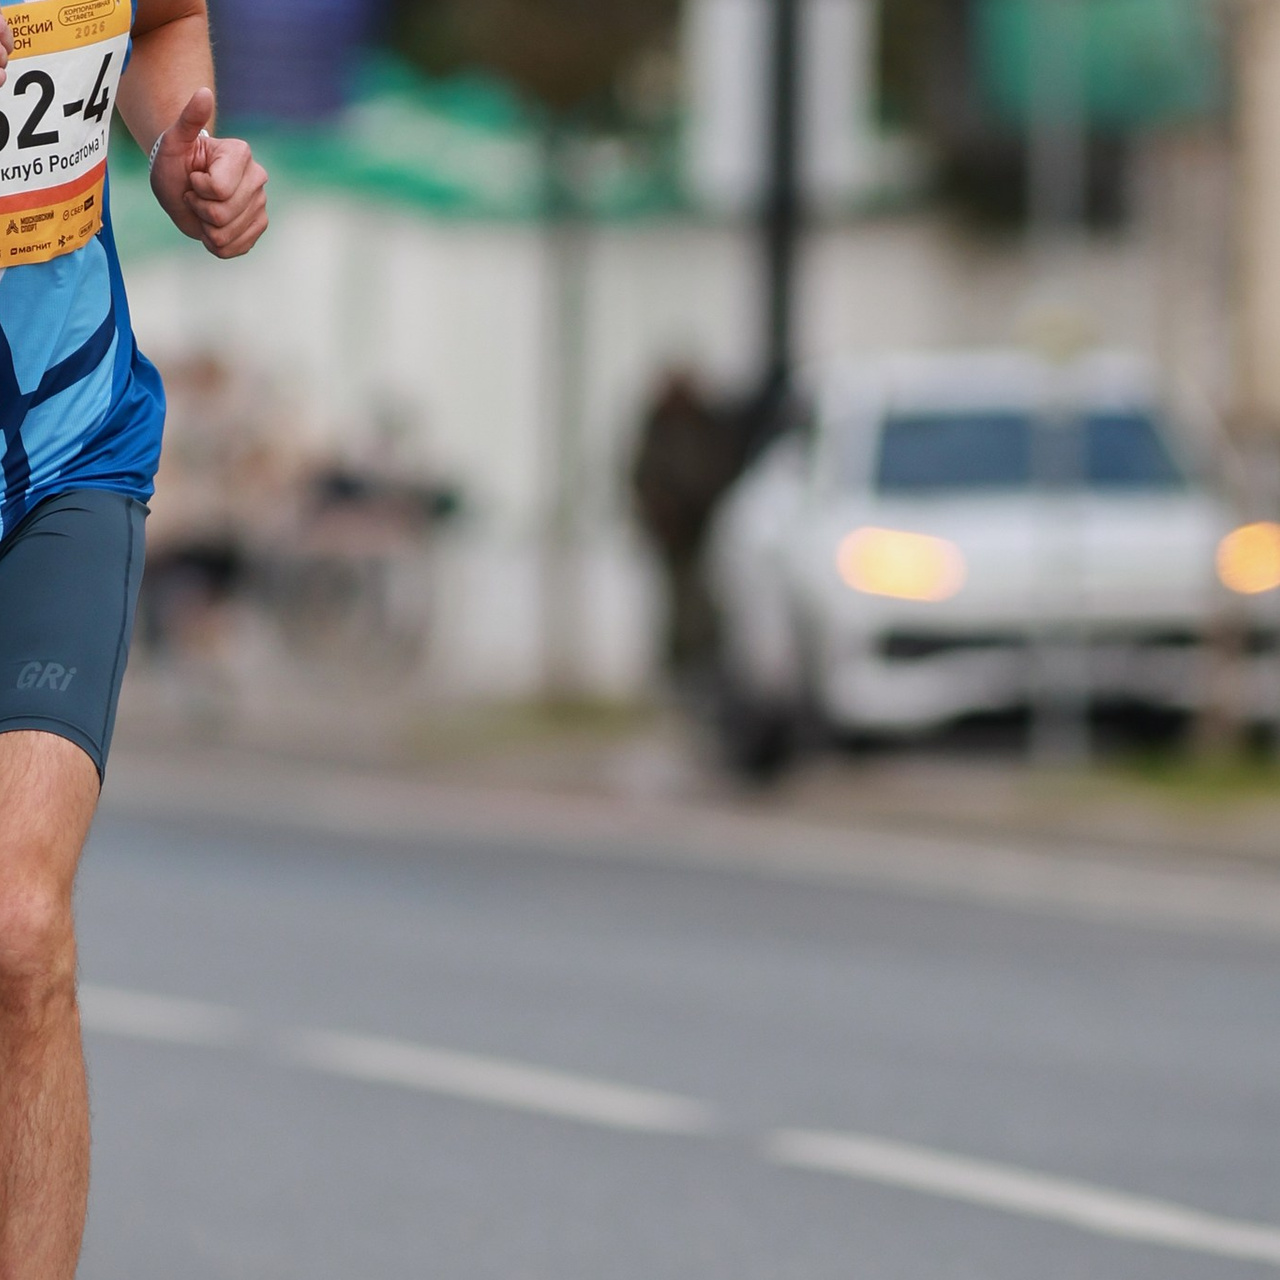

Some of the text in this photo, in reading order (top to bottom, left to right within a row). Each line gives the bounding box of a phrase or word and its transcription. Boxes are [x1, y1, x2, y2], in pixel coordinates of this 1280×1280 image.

[64, 11, 95, 24] ЭСТАФЕТА
[1, 158, 44, 181] клуб
[49, 137, 100, 173] Росатома
[100, 128, 106, 146] 1
